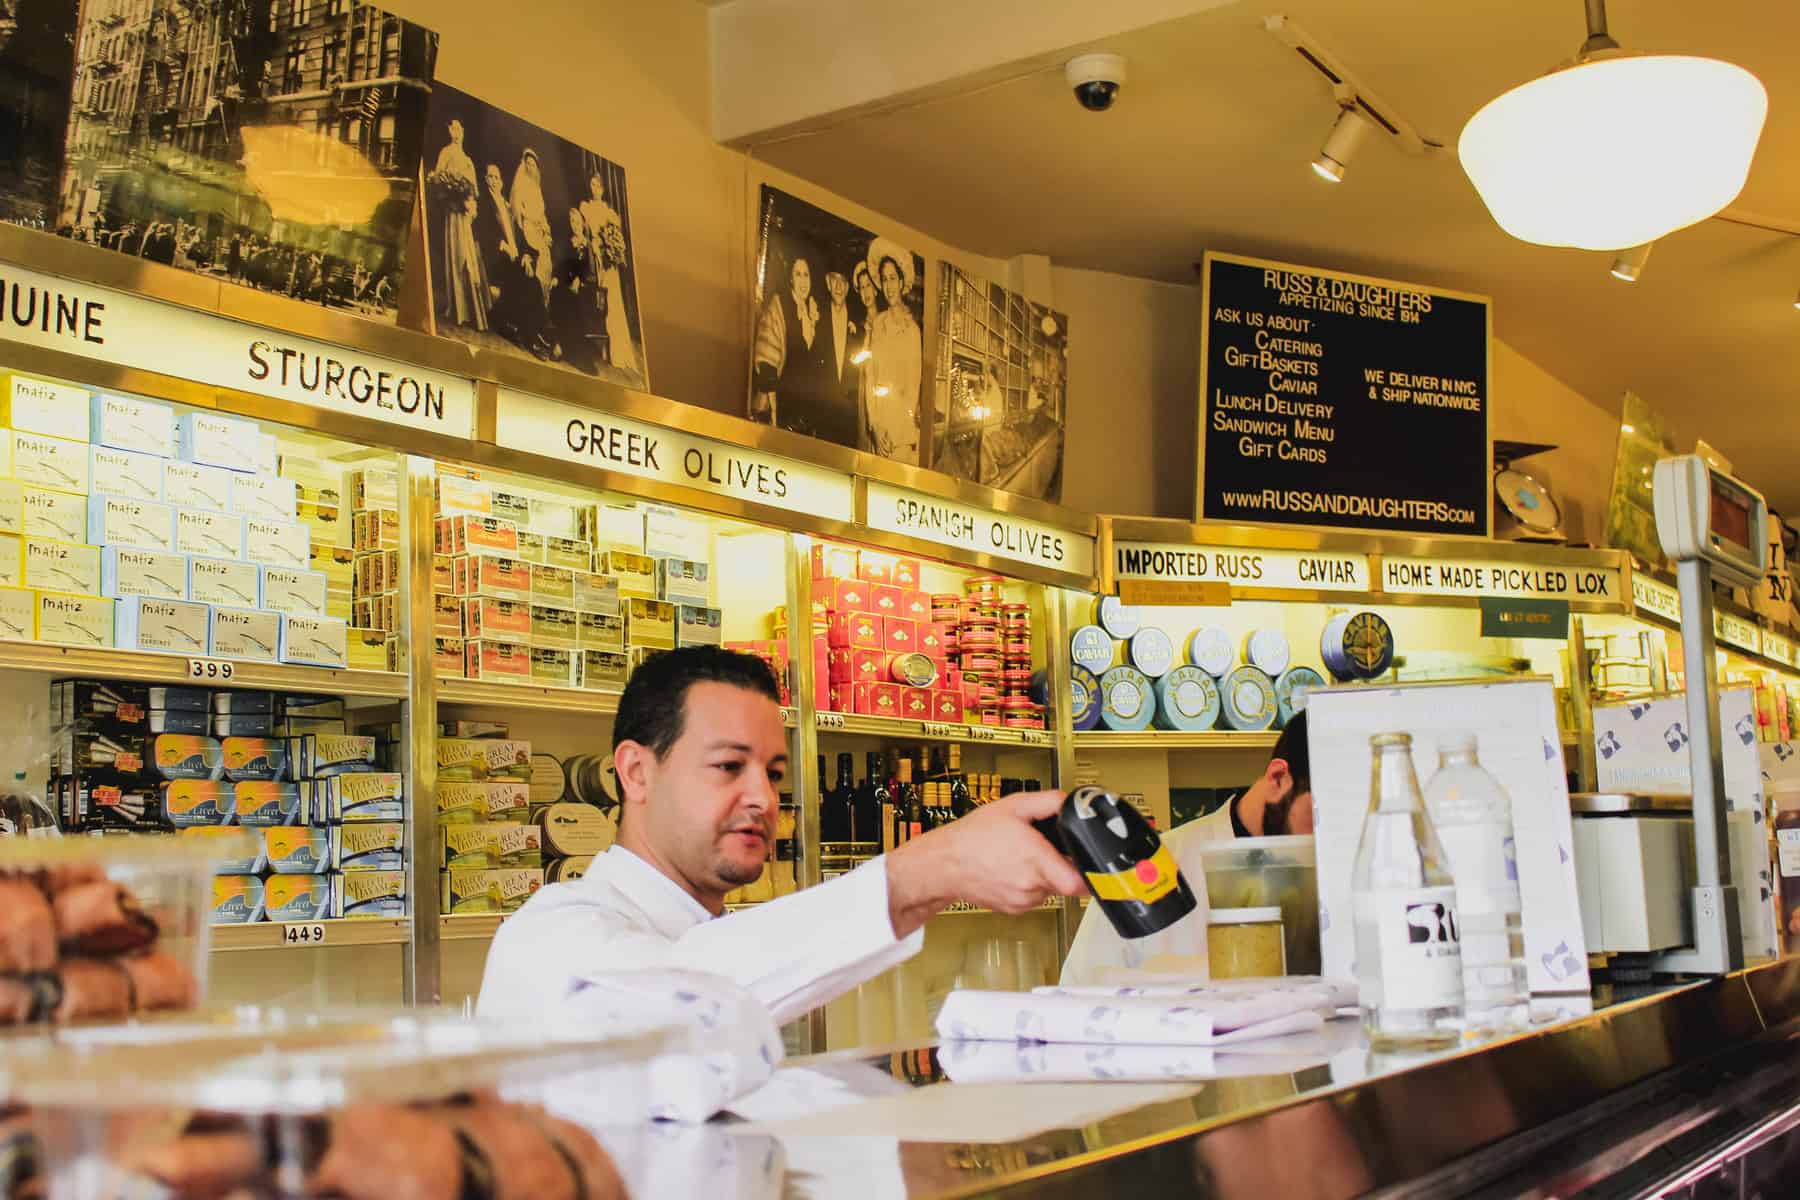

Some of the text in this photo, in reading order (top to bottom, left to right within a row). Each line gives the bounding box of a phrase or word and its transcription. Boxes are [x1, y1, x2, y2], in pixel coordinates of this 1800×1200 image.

[1264, 270, 1432, 313] RUSS & DAUGHTERS
[1279, 292, 1354, 315] APPETIZING
[1359, 303, 1395, 321] SINCE
[1215, 307, 1241, 324] ASK
[1246, 311, 1264, 327] US
[0, 279, 445, 421] UINE STURGEON
[1364, 367, 1477, 396] WE DELIVER IN NYC
[1368, 386, 1480, 412] & SHIP NATIONWIDE
[566, 419, 787, 498] GREEK OLIVES
[896, 499, 1064, 561] SPANISH OLIVES
[1117, 549, 1356, 583] IMPORTED RUSS CAVIAR
[1388, 563, 1608, 596] HOME MADE PICKLED LOX
[192, 661, 233, 679] 399
[288, 926, 323, 943] 449
